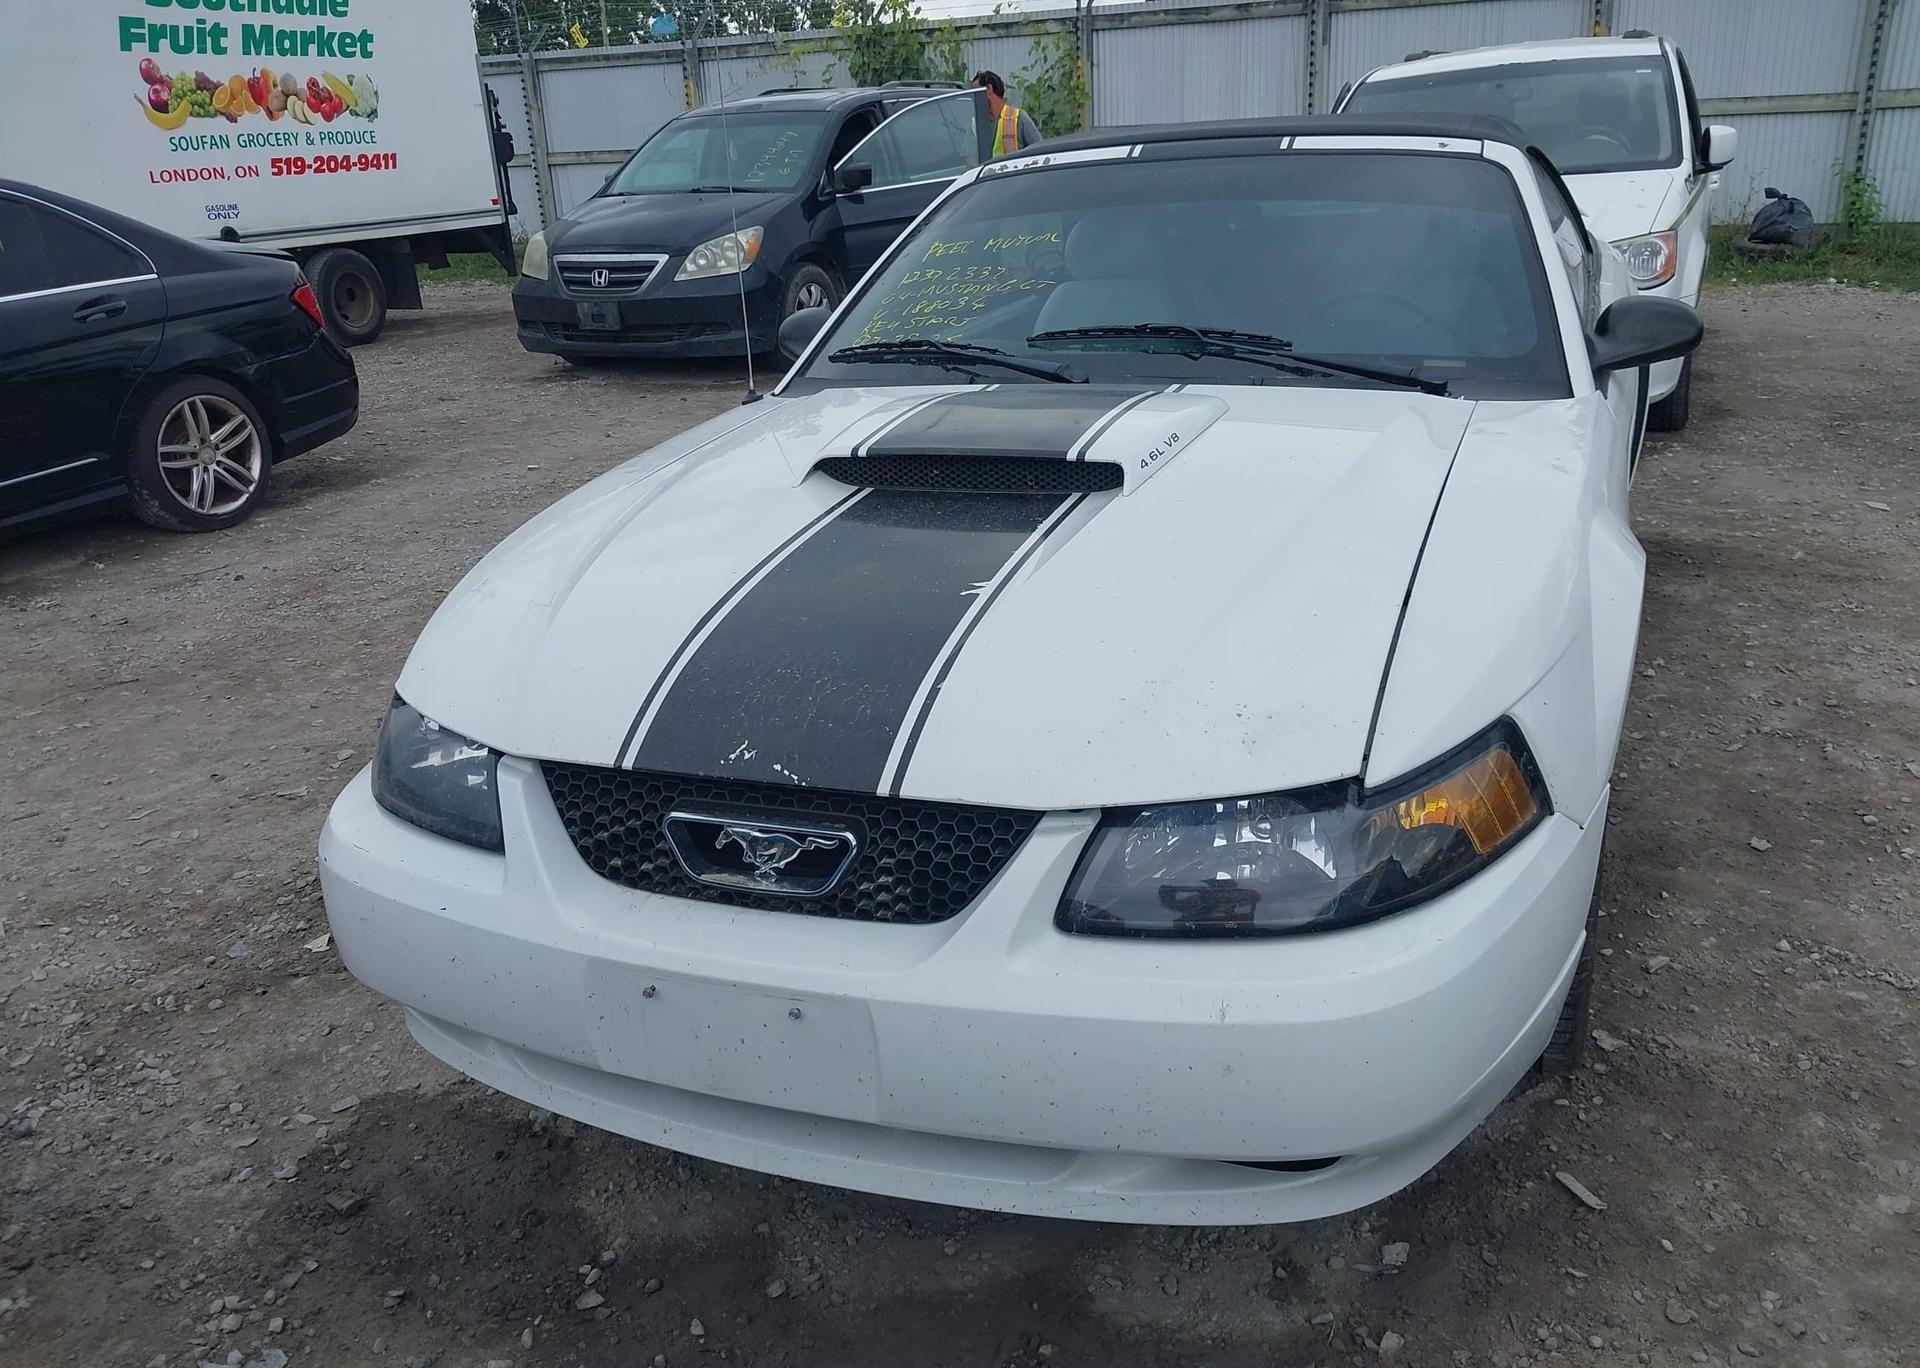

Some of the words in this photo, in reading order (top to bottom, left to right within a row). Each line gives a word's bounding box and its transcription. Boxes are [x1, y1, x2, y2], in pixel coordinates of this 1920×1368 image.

[118, 15, 228, 56] Fruit
[241, 23, 374, 59] Market
[169, 134, 231, 152] SOUFAN
[237, 132, 299, 148] GROCERY
[305, 132, 315, 146] &
[319, 130, 377, 146] PRODUCE
[149, 167, 231, 184] LONDON,
[235, 165, 260, 178] ON
[270, 152, 397, 177] 519-204-9411
[205, 203, 240, 212] GASOLINE
[207, 211, 240, 220] ONLY
[1139, 447, 1166, 469] 4.6L
[1163, 432, 1180, 448] V8
